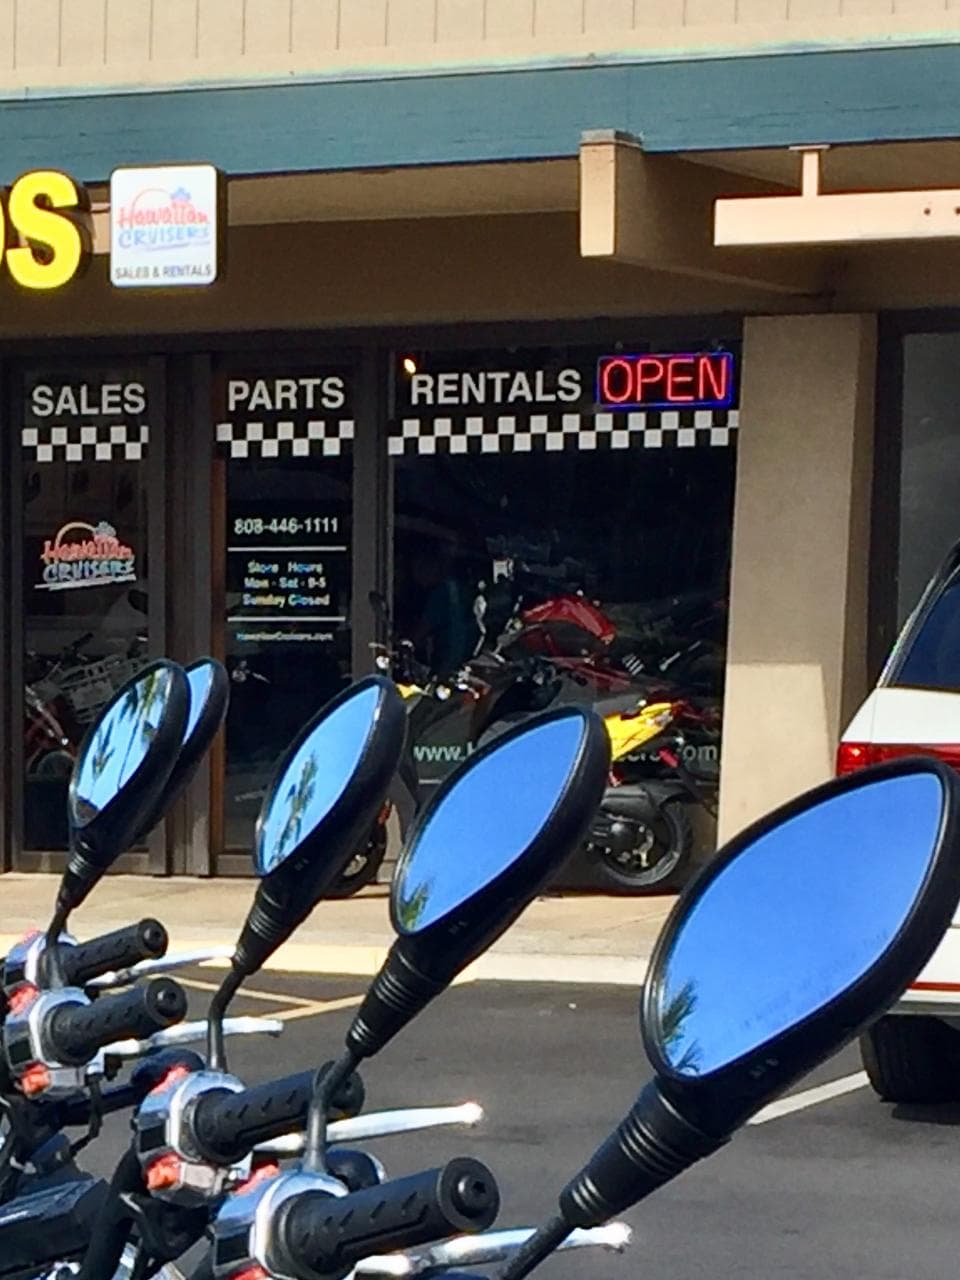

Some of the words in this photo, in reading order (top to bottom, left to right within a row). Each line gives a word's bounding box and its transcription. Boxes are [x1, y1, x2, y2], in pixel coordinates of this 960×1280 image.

[114, 266, 150, 279] SALES
[163, 264, 211, 277] RENTALS
[228, 377, 345, 411] PARTS
[411, 369, 582, 405] RENTALS
[603, 357, 728, 402] OPEN
[31, 383, 146, 416] SALES
[234, 517, 338, 535] 808-446-1111
